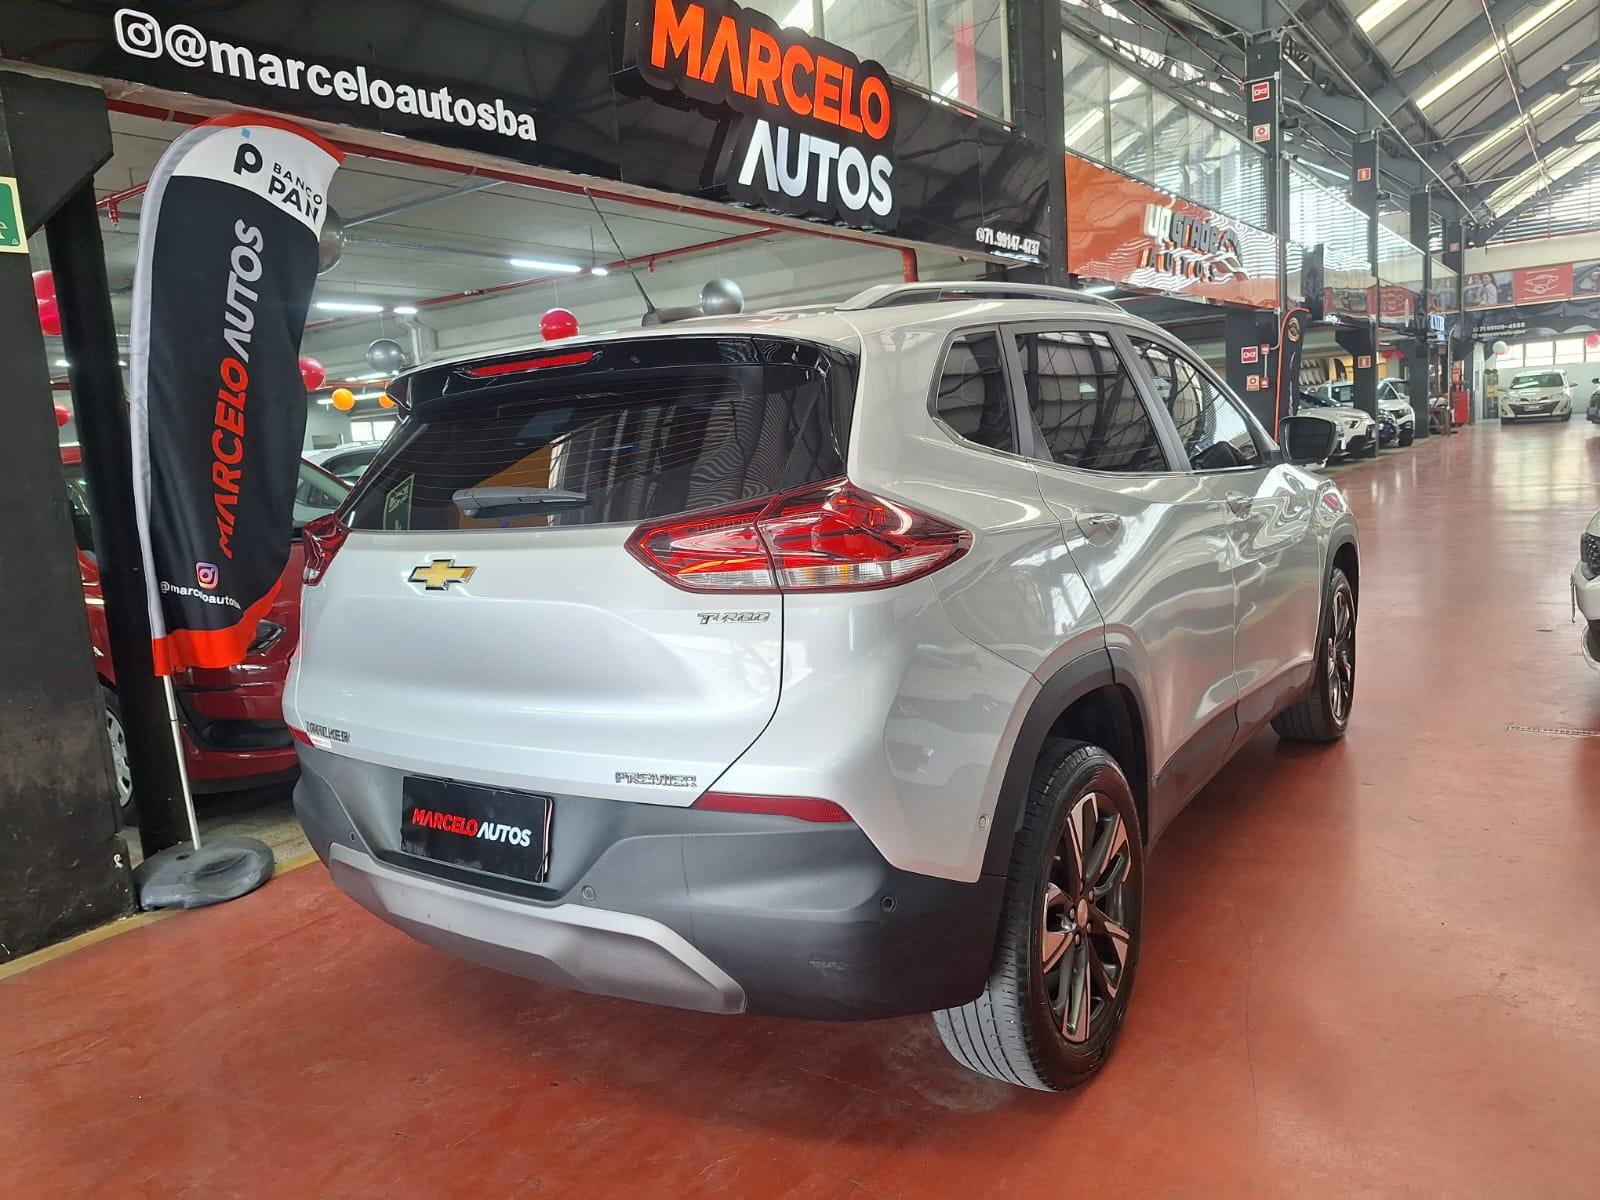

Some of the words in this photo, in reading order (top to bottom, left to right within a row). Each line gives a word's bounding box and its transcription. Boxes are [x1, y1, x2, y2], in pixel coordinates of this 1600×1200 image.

[165, 24, 537, 142] @marceloautosba
[651, 0, 891, 140] MARCELO
[273, 162, 323, 205] BANCO
[738, 119, 893, 216] AUTOS
[268, 176, 319, 225] PAN
[697, 611, 771, 625] TURBO
[615, 771, 698, 788] PREMIER
